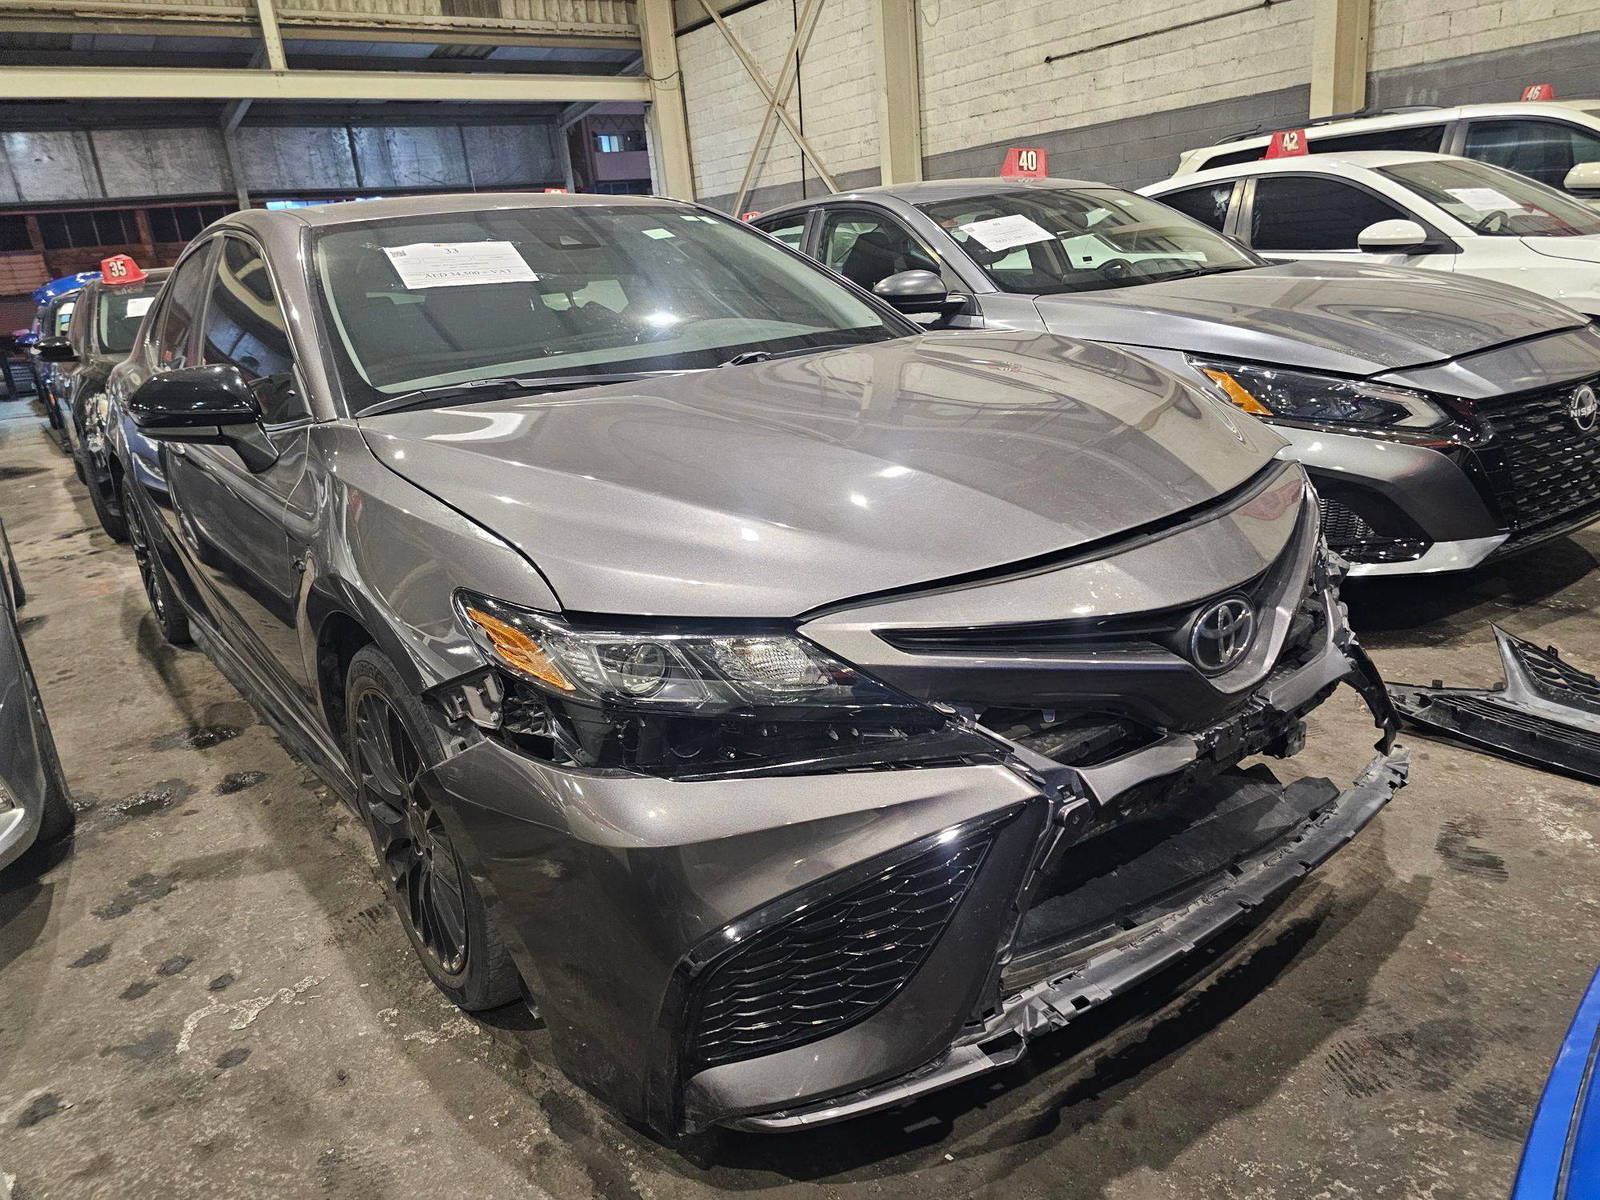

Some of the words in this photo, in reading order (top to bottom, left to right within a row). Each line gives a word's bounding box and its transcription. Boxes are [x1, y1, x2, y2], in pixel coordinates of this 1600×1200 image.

[1283, 131, 1300, 151] 42
[1018, 150, 1037, 171] 40
[109, 260, 127, 277] 35
